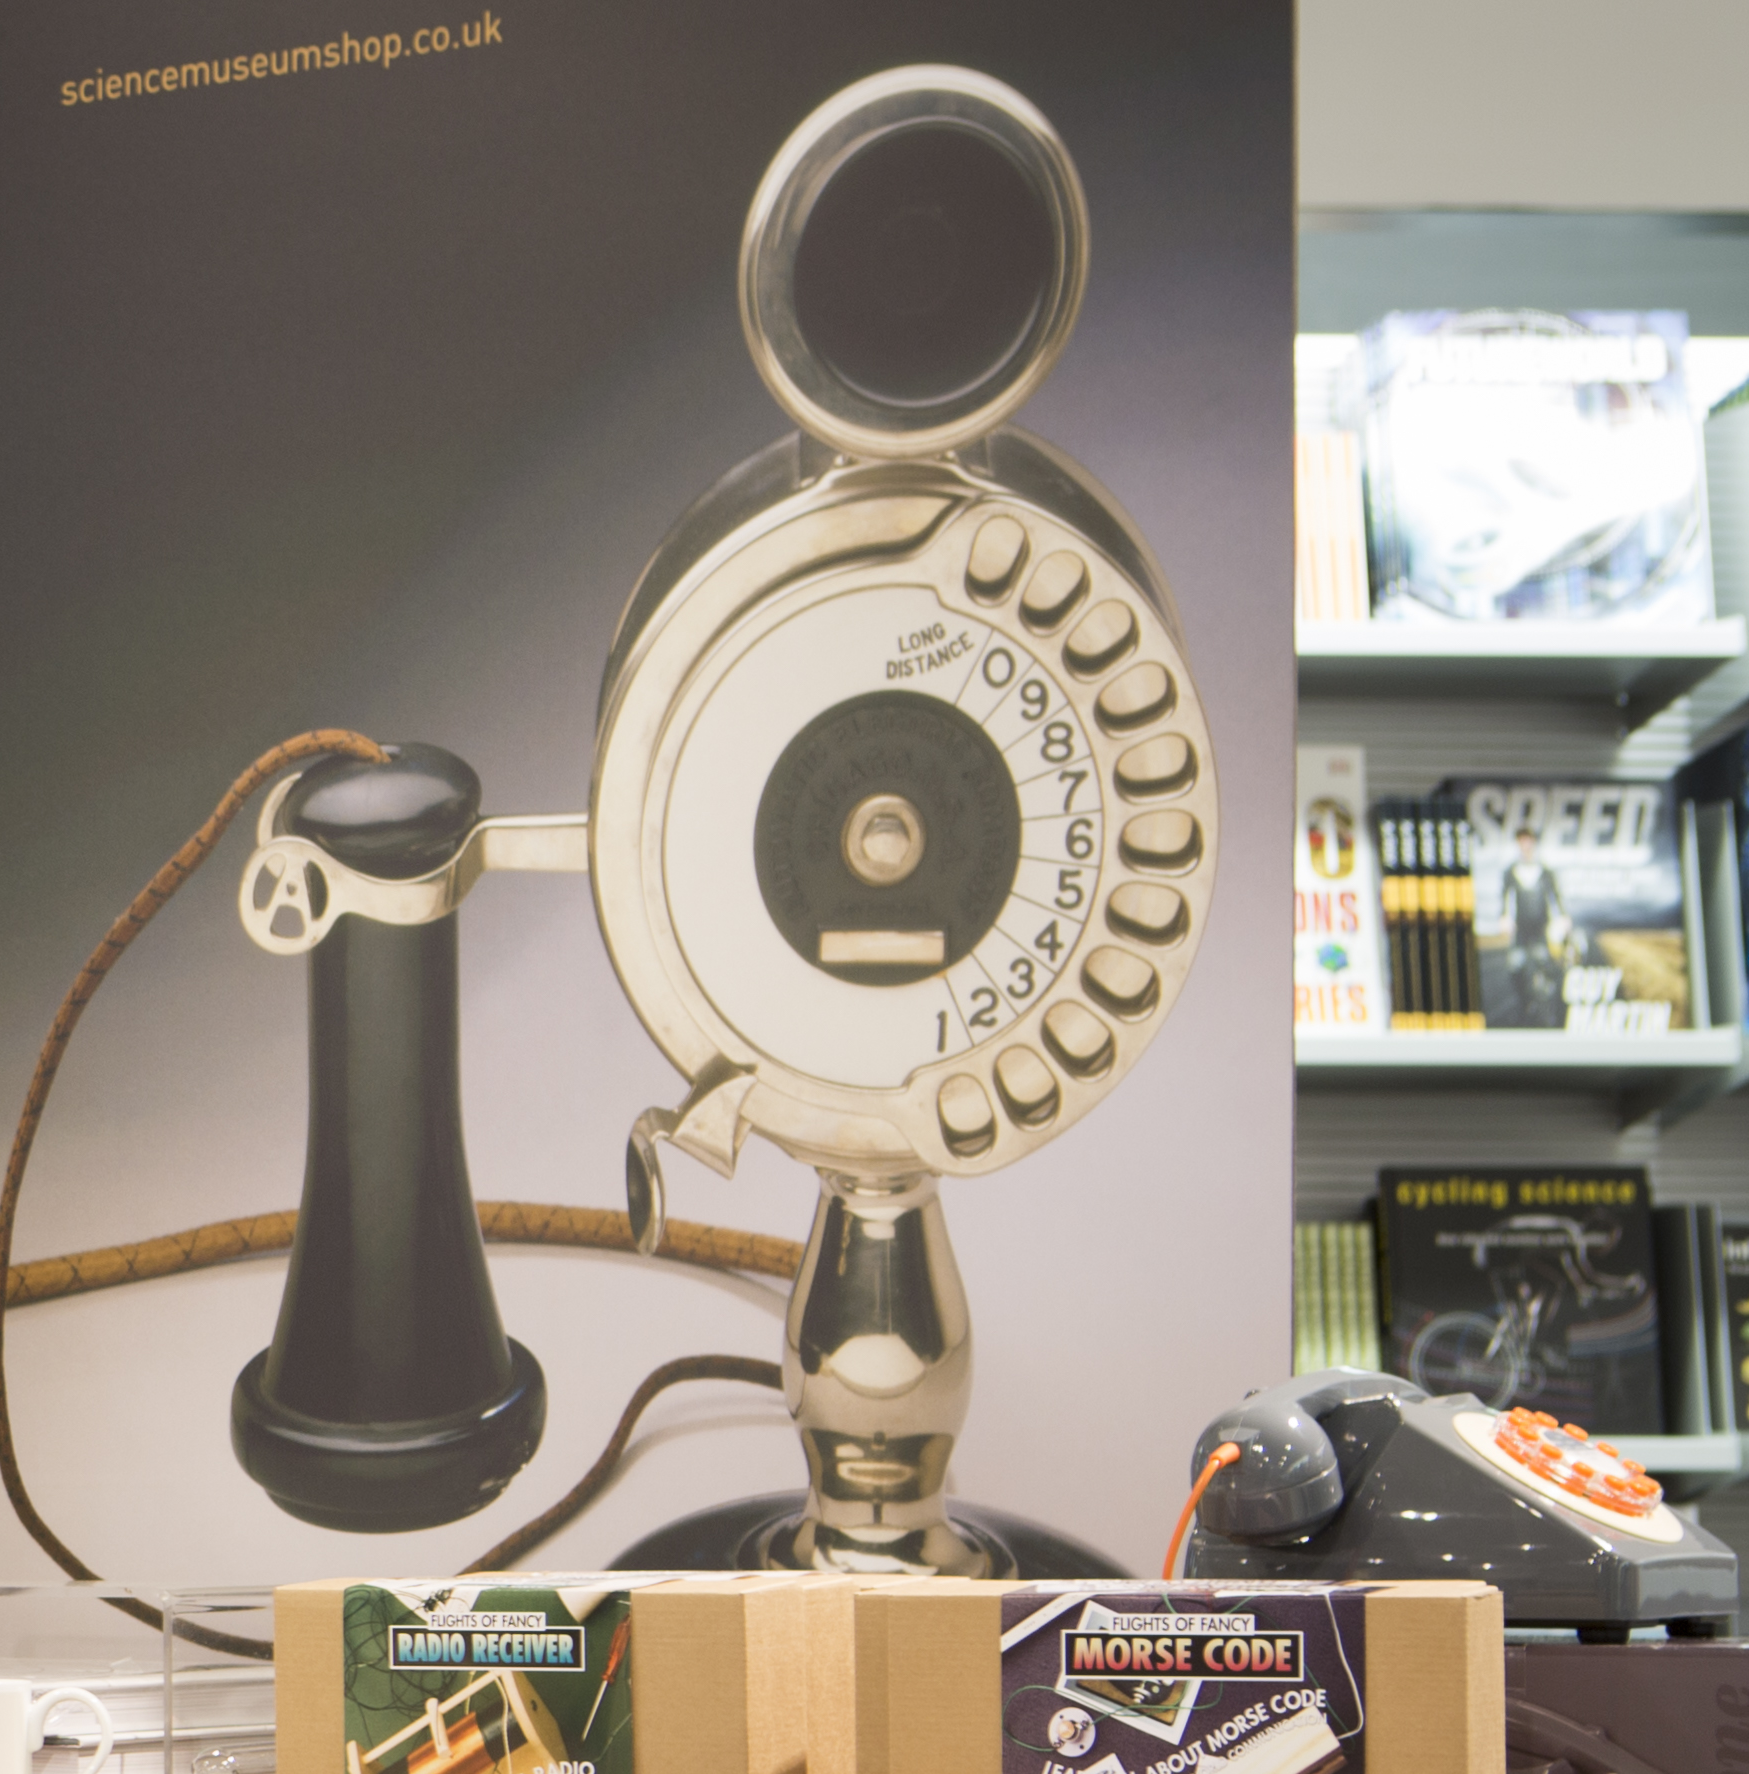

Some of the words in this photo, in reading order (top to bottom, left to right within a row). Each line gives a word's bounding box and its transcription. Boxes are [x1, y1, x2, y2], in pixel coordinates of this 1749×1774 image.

[60, 10, 503, 105] sciencemuseumshop.co.uk
[885, 632, 975, 680] DISTANCE
[897, 622, 946, 654] LONG
[982, 647, 1016, 688] 0
[1020, 680, 1049, 721] 9
[1040, 723, 1074, 762] 8
[1058, 770, 1088, 813] 7
[1064, 818, 1094, 859] 6
[1054, 870, 1083, 910] 5
[1034, 920, 1063, 961] 4
[1007, 957, 1036, 999] 3
[969, 986, 1000, 1027] 2
[936, 1010, 948, 1053] 1
[1396, 1176, 1509, 1210] cycling
[1518, 1175, 1637, 1206] science
[430, 1613, 476, 1629] FLIGHTS
[479, 1613, 499, 1629] OF
[502, 1613, 544, 1630] FANCY
[1112, 1616, 1170, 1632] FLIGHTS
[1174, 1616, 1197, 1632] OF
[1199, 1616, 1252, 1632] FANCY
[397, 1632, 466, 1664] RADIO
[471, 1632, 575, 1666] RECEIVER
[1073, 1636, 1193, 1671] MORSE
[1203, 1637, 1293, 1673] CODE
[1205, 1701, 1270, 1754] MORSE
[1269, 1688, 1327, 1716] CODE
